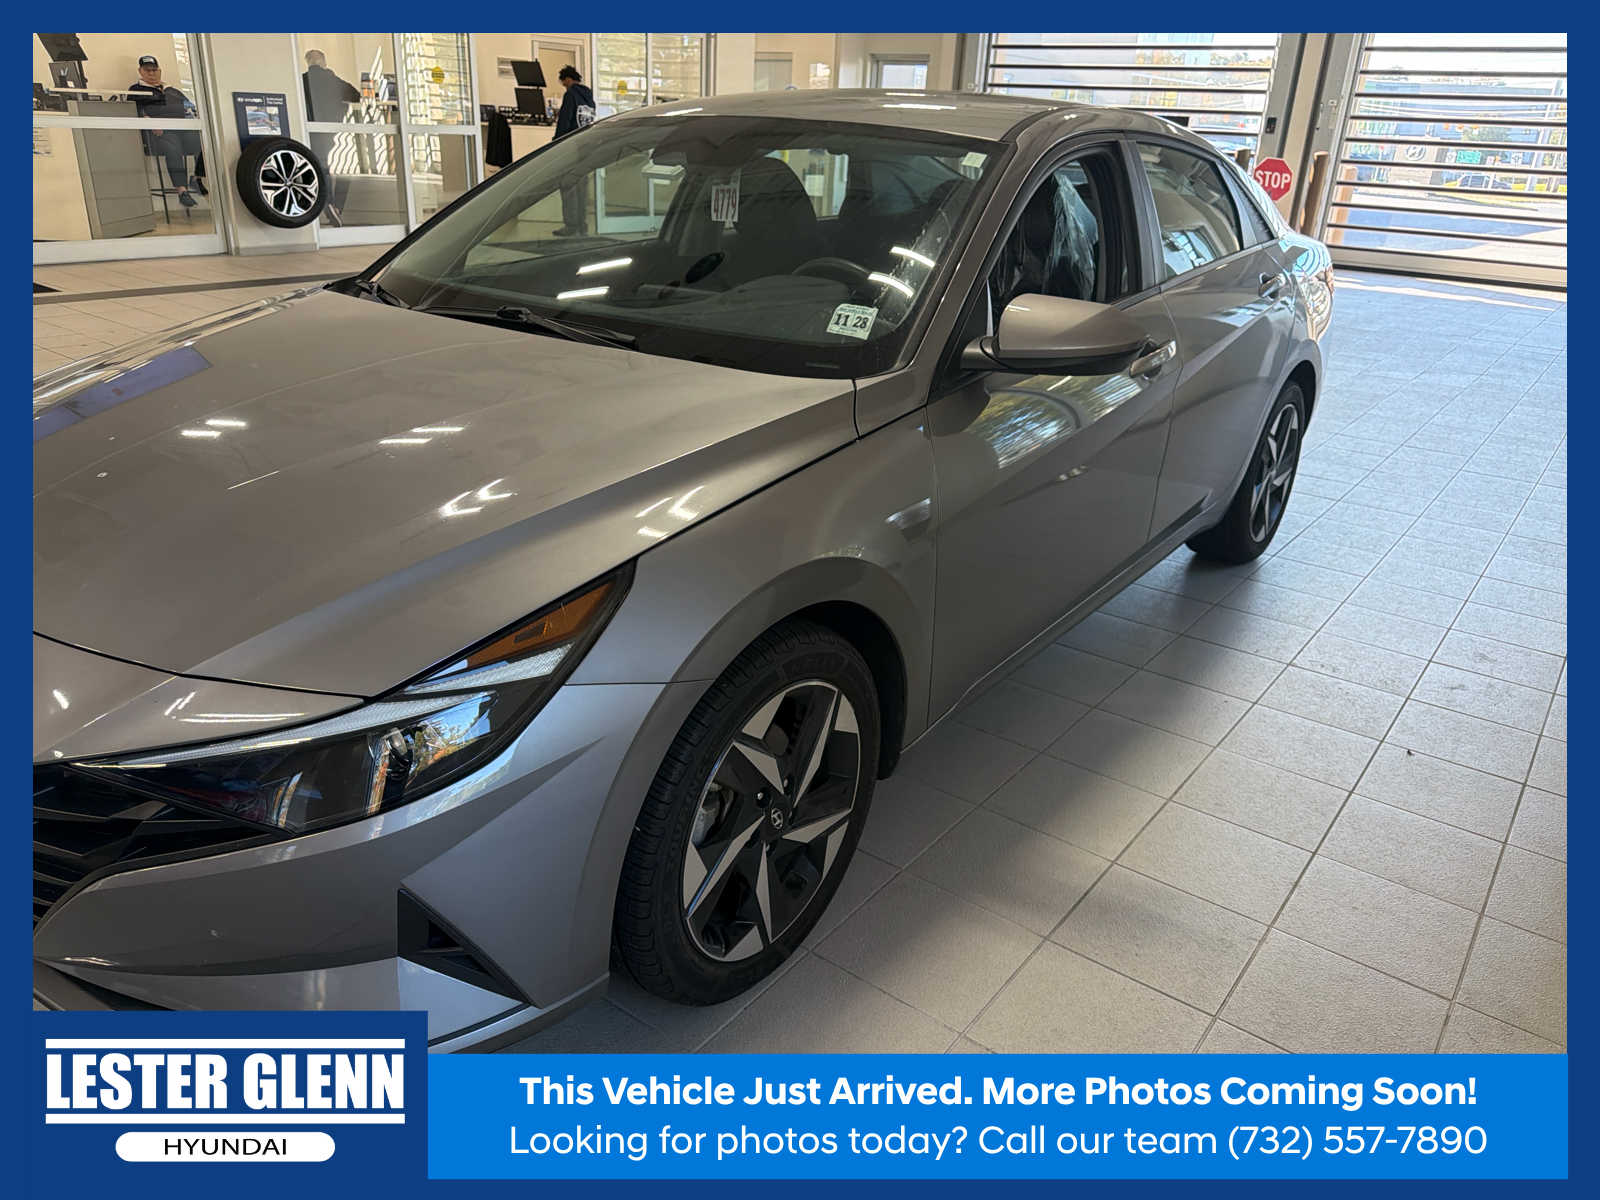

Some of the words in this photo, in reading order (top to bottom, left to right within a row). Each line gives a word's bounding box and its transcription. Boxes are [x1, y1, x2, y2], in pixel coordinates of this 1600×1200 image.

[1255, 170, 1291, 189] STOP
[833, 313, 850, 326] 11
[852, 315, 870, 329] 28
